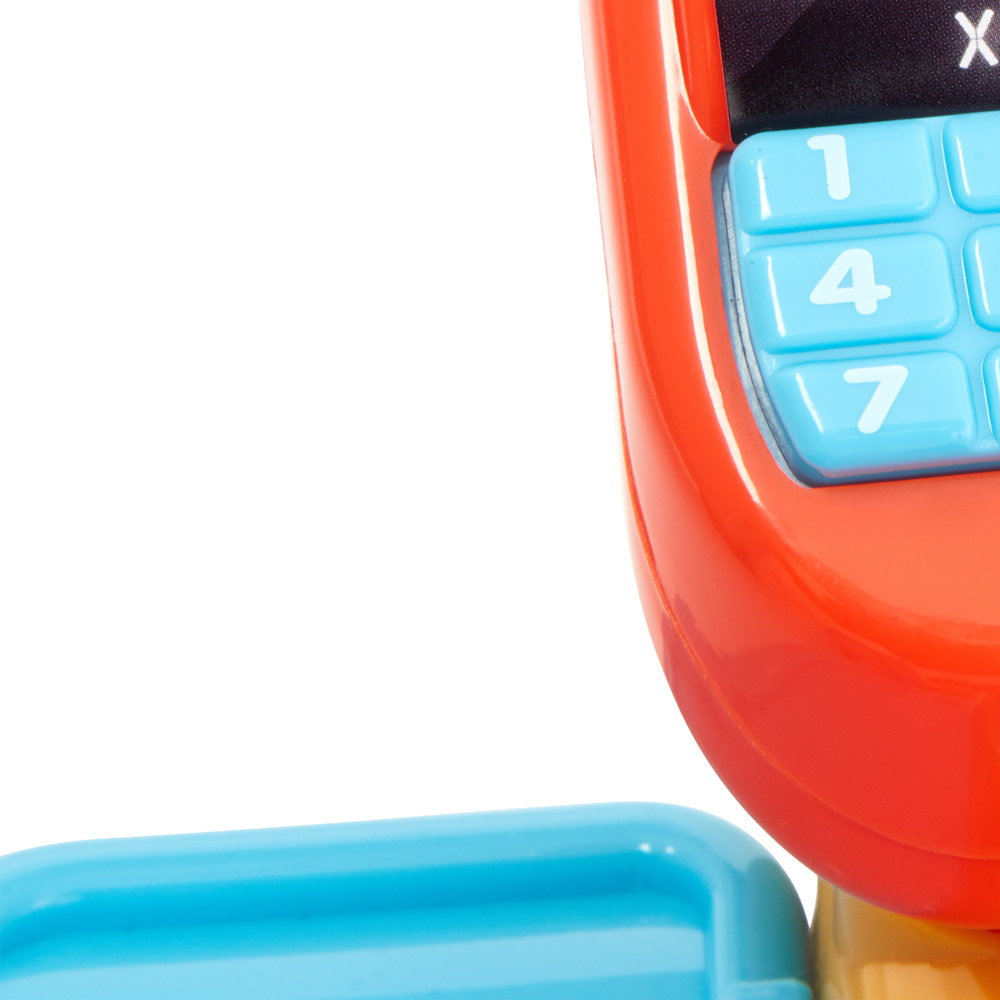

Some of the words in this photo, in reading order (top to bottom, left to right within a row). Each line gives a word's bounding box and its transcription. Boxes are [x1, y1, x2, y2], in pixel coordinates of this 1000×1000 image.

[806, 134, 851, 200] 1
[809, 248, 892, 315] 4
[843, 364, 909, 434] 7
